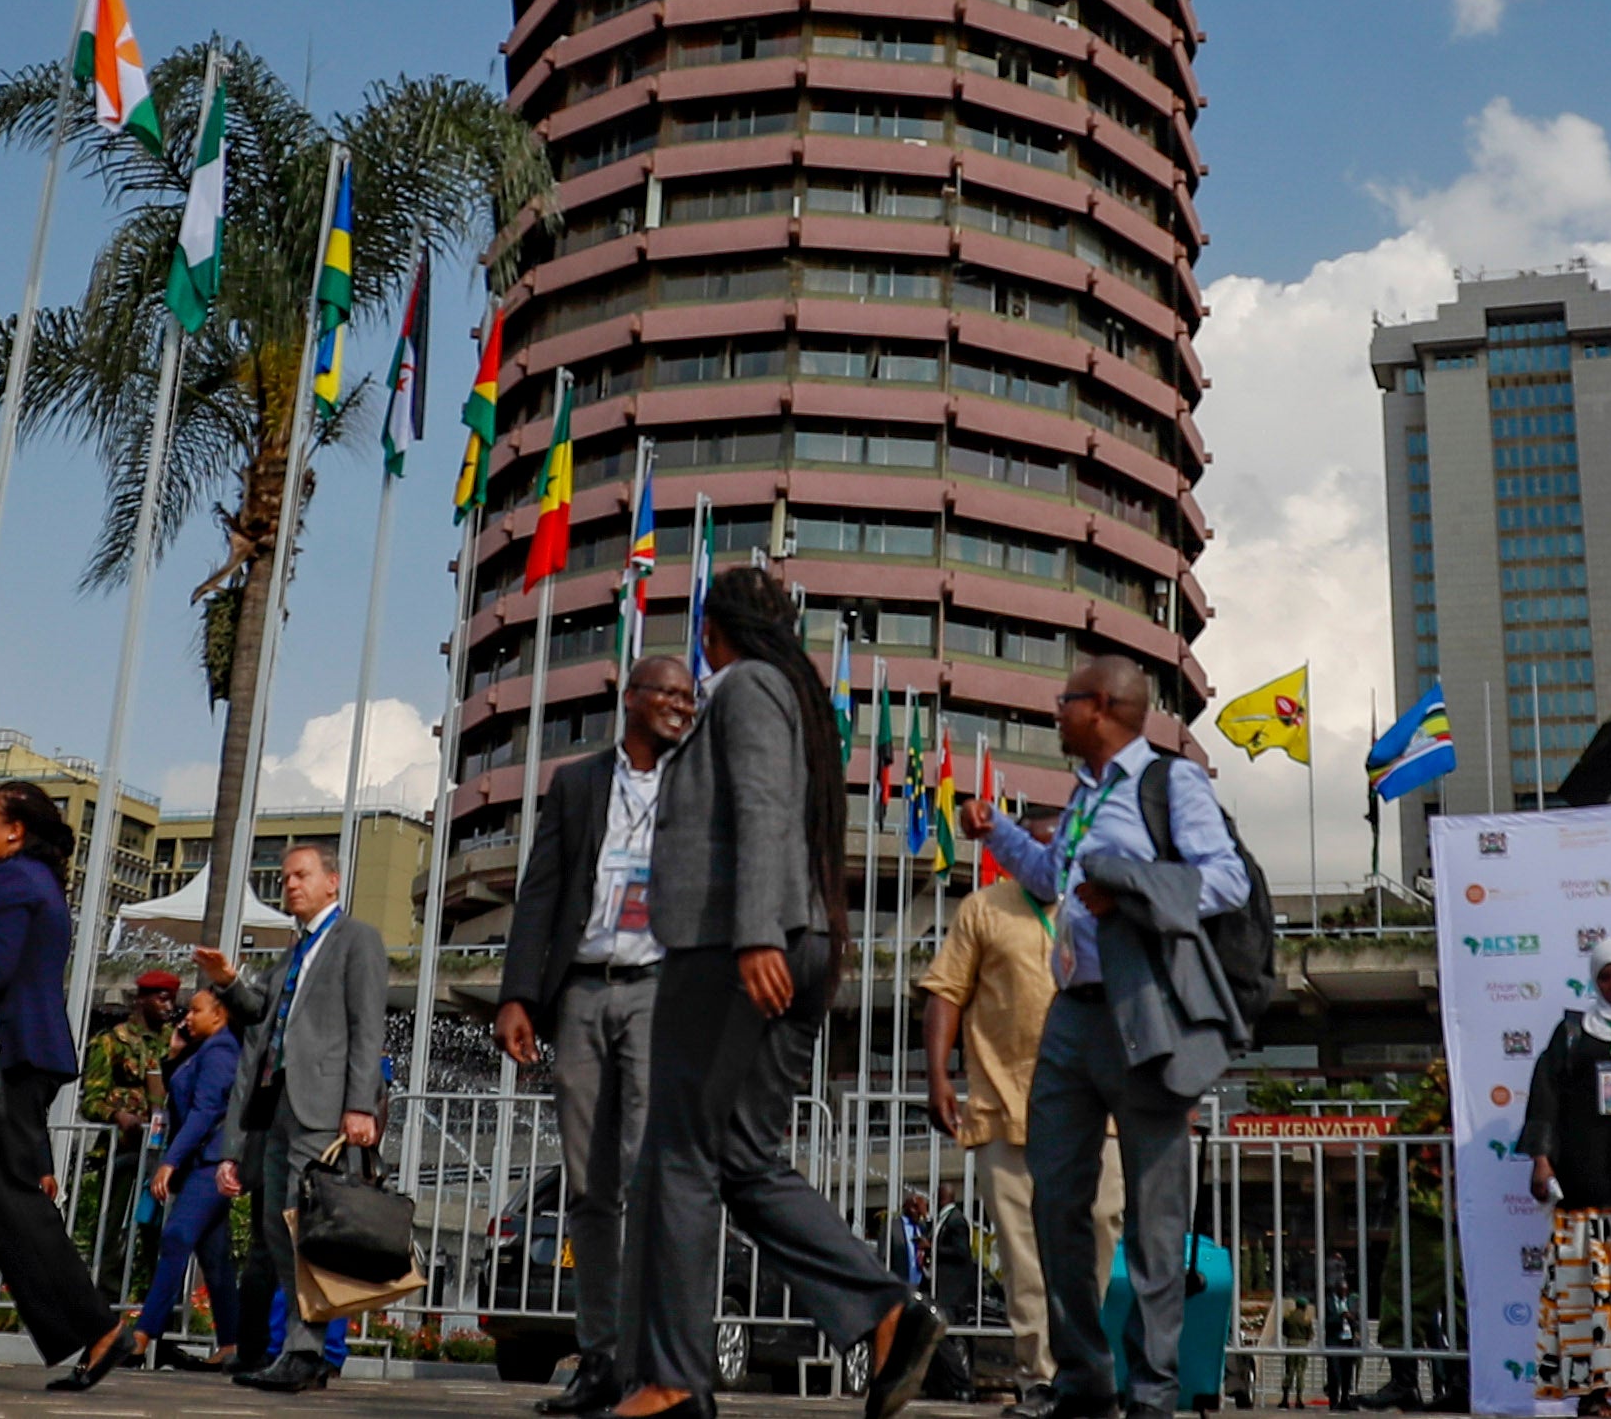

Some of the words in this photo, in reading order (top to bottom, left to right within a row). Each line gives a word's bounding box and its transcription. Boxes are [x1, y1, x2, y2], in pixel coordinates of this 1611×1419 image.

[1483, 934, 1540, 955] ACS23
[1235, 1122, 1273, 1137] THE
[1279, 1122, 1379, 1137] KENYATTA
